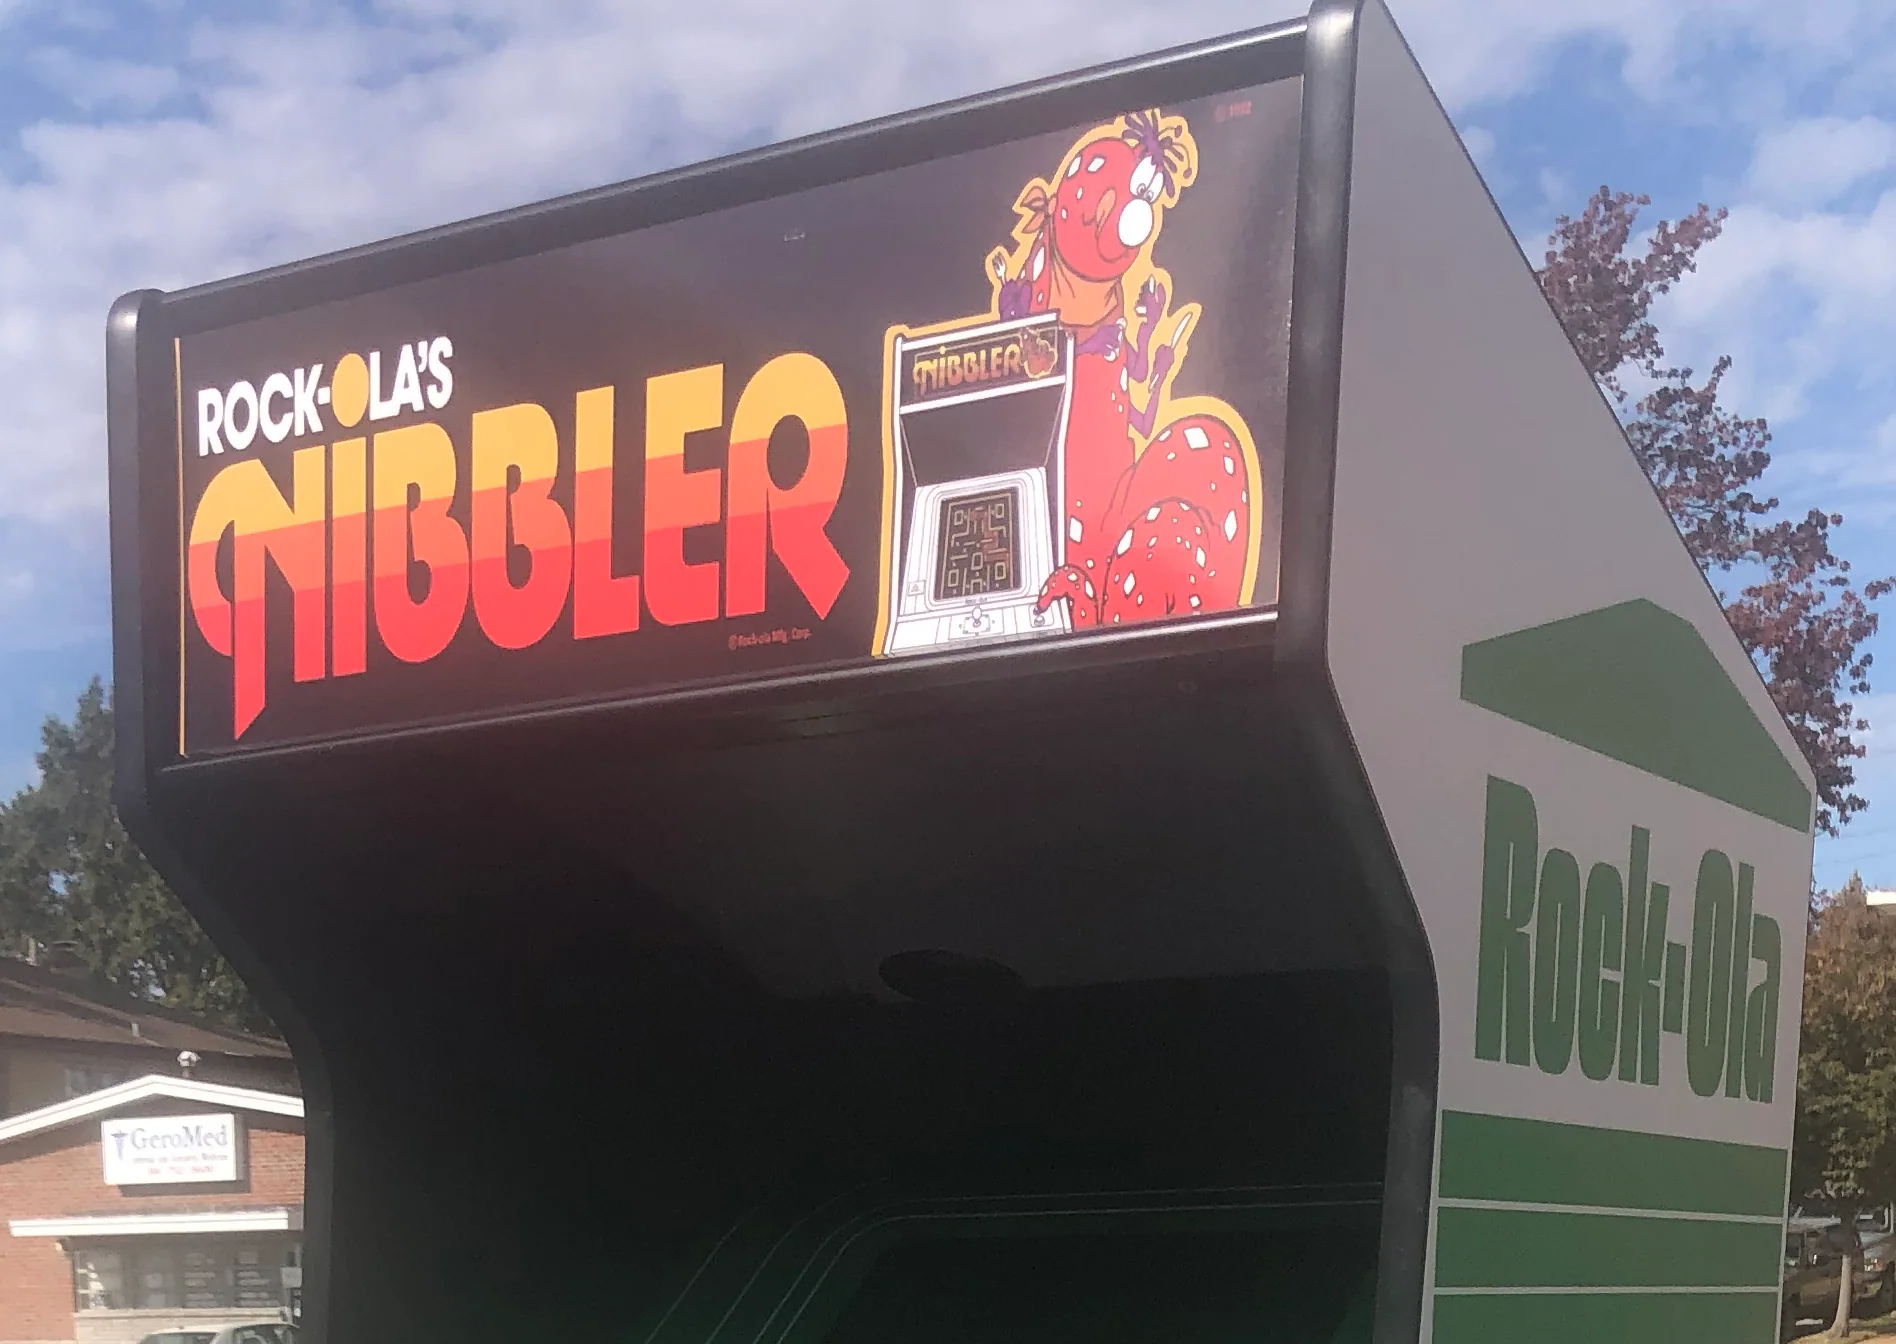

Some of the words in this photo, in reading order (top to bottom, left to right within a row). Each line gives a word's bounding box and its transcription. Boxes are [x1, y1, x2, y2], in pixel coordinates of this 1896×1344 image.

[198, 335, 454, 457] ROCK-OLA'S
[912, 342, 1021, 397] NIBBLER
[187, 351, 851, 741] NIBBLER
[1474, 773, 1783, 1104] Rock-Ola
[131, 1124, 228, 1149] GeroMed
